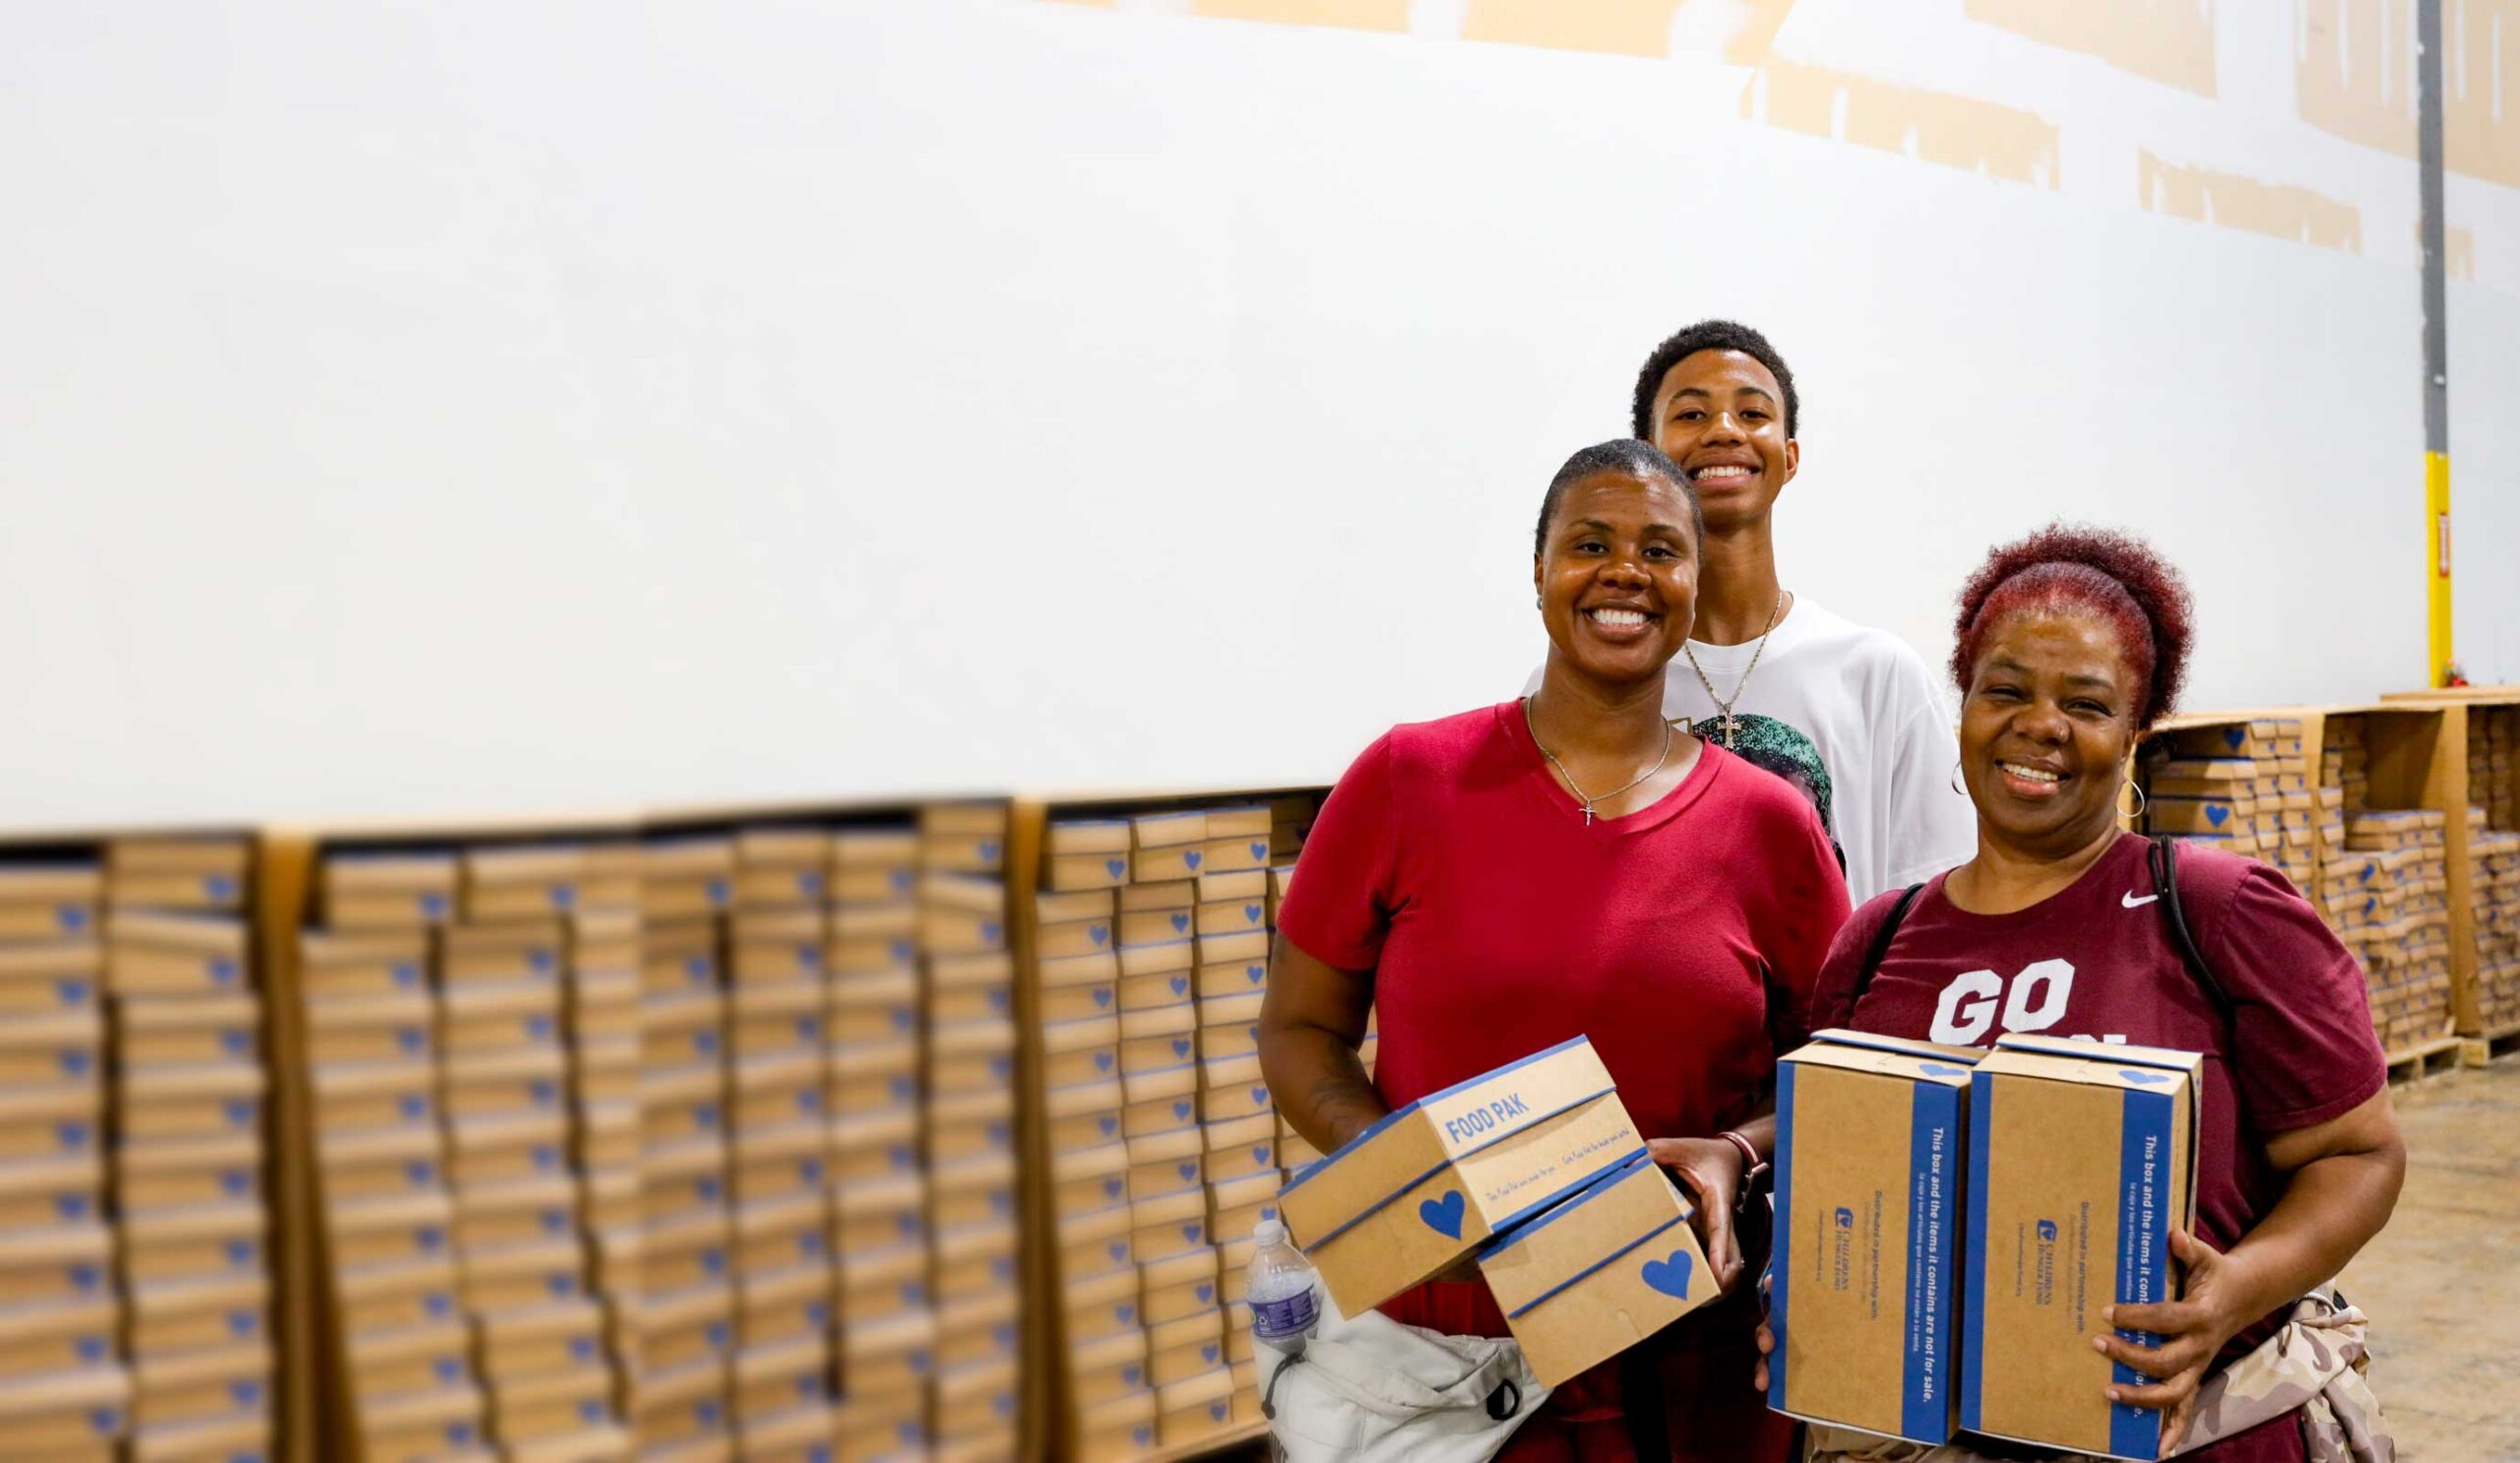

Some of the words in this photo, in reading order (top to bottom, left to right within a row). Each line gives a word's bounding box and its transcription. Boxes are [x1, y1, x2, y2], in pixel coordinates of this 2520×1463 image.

[1929, 958, 2075, 1047] GO
[1445, 1108, 1496, 1144] FOOD
[1489, 1092, 1531, 1122] PAK
[1932, 1127, 1944, 1151] This
[2144, 1135, 2157, 1160] This
[1932, 1153, 1943, 1174] box
[2144, 1162, 2156, 1183] box
[1930, 1177, 1941, 1198] and
[2143, 1185, 2154, 1208] and
[1929, 1200, 1940, 1219] the
[2142, 1210, 2153, 1230] the
[1928, 1221, 1941, 1253] items
[2140, 1232, 2153, 1264] items
[1928, 1255, 1939, 1264] it
[2140, 1266, 2151, 1275] it
[1925, 1266, 1937, 1313] contains
[1925, 1315, 1935, 1334] are
[1925, 1336, 1935, 1355] not
[1924, 1357, 1935, 1374] for
[1922, 1375, 1933, 1403] sale.
